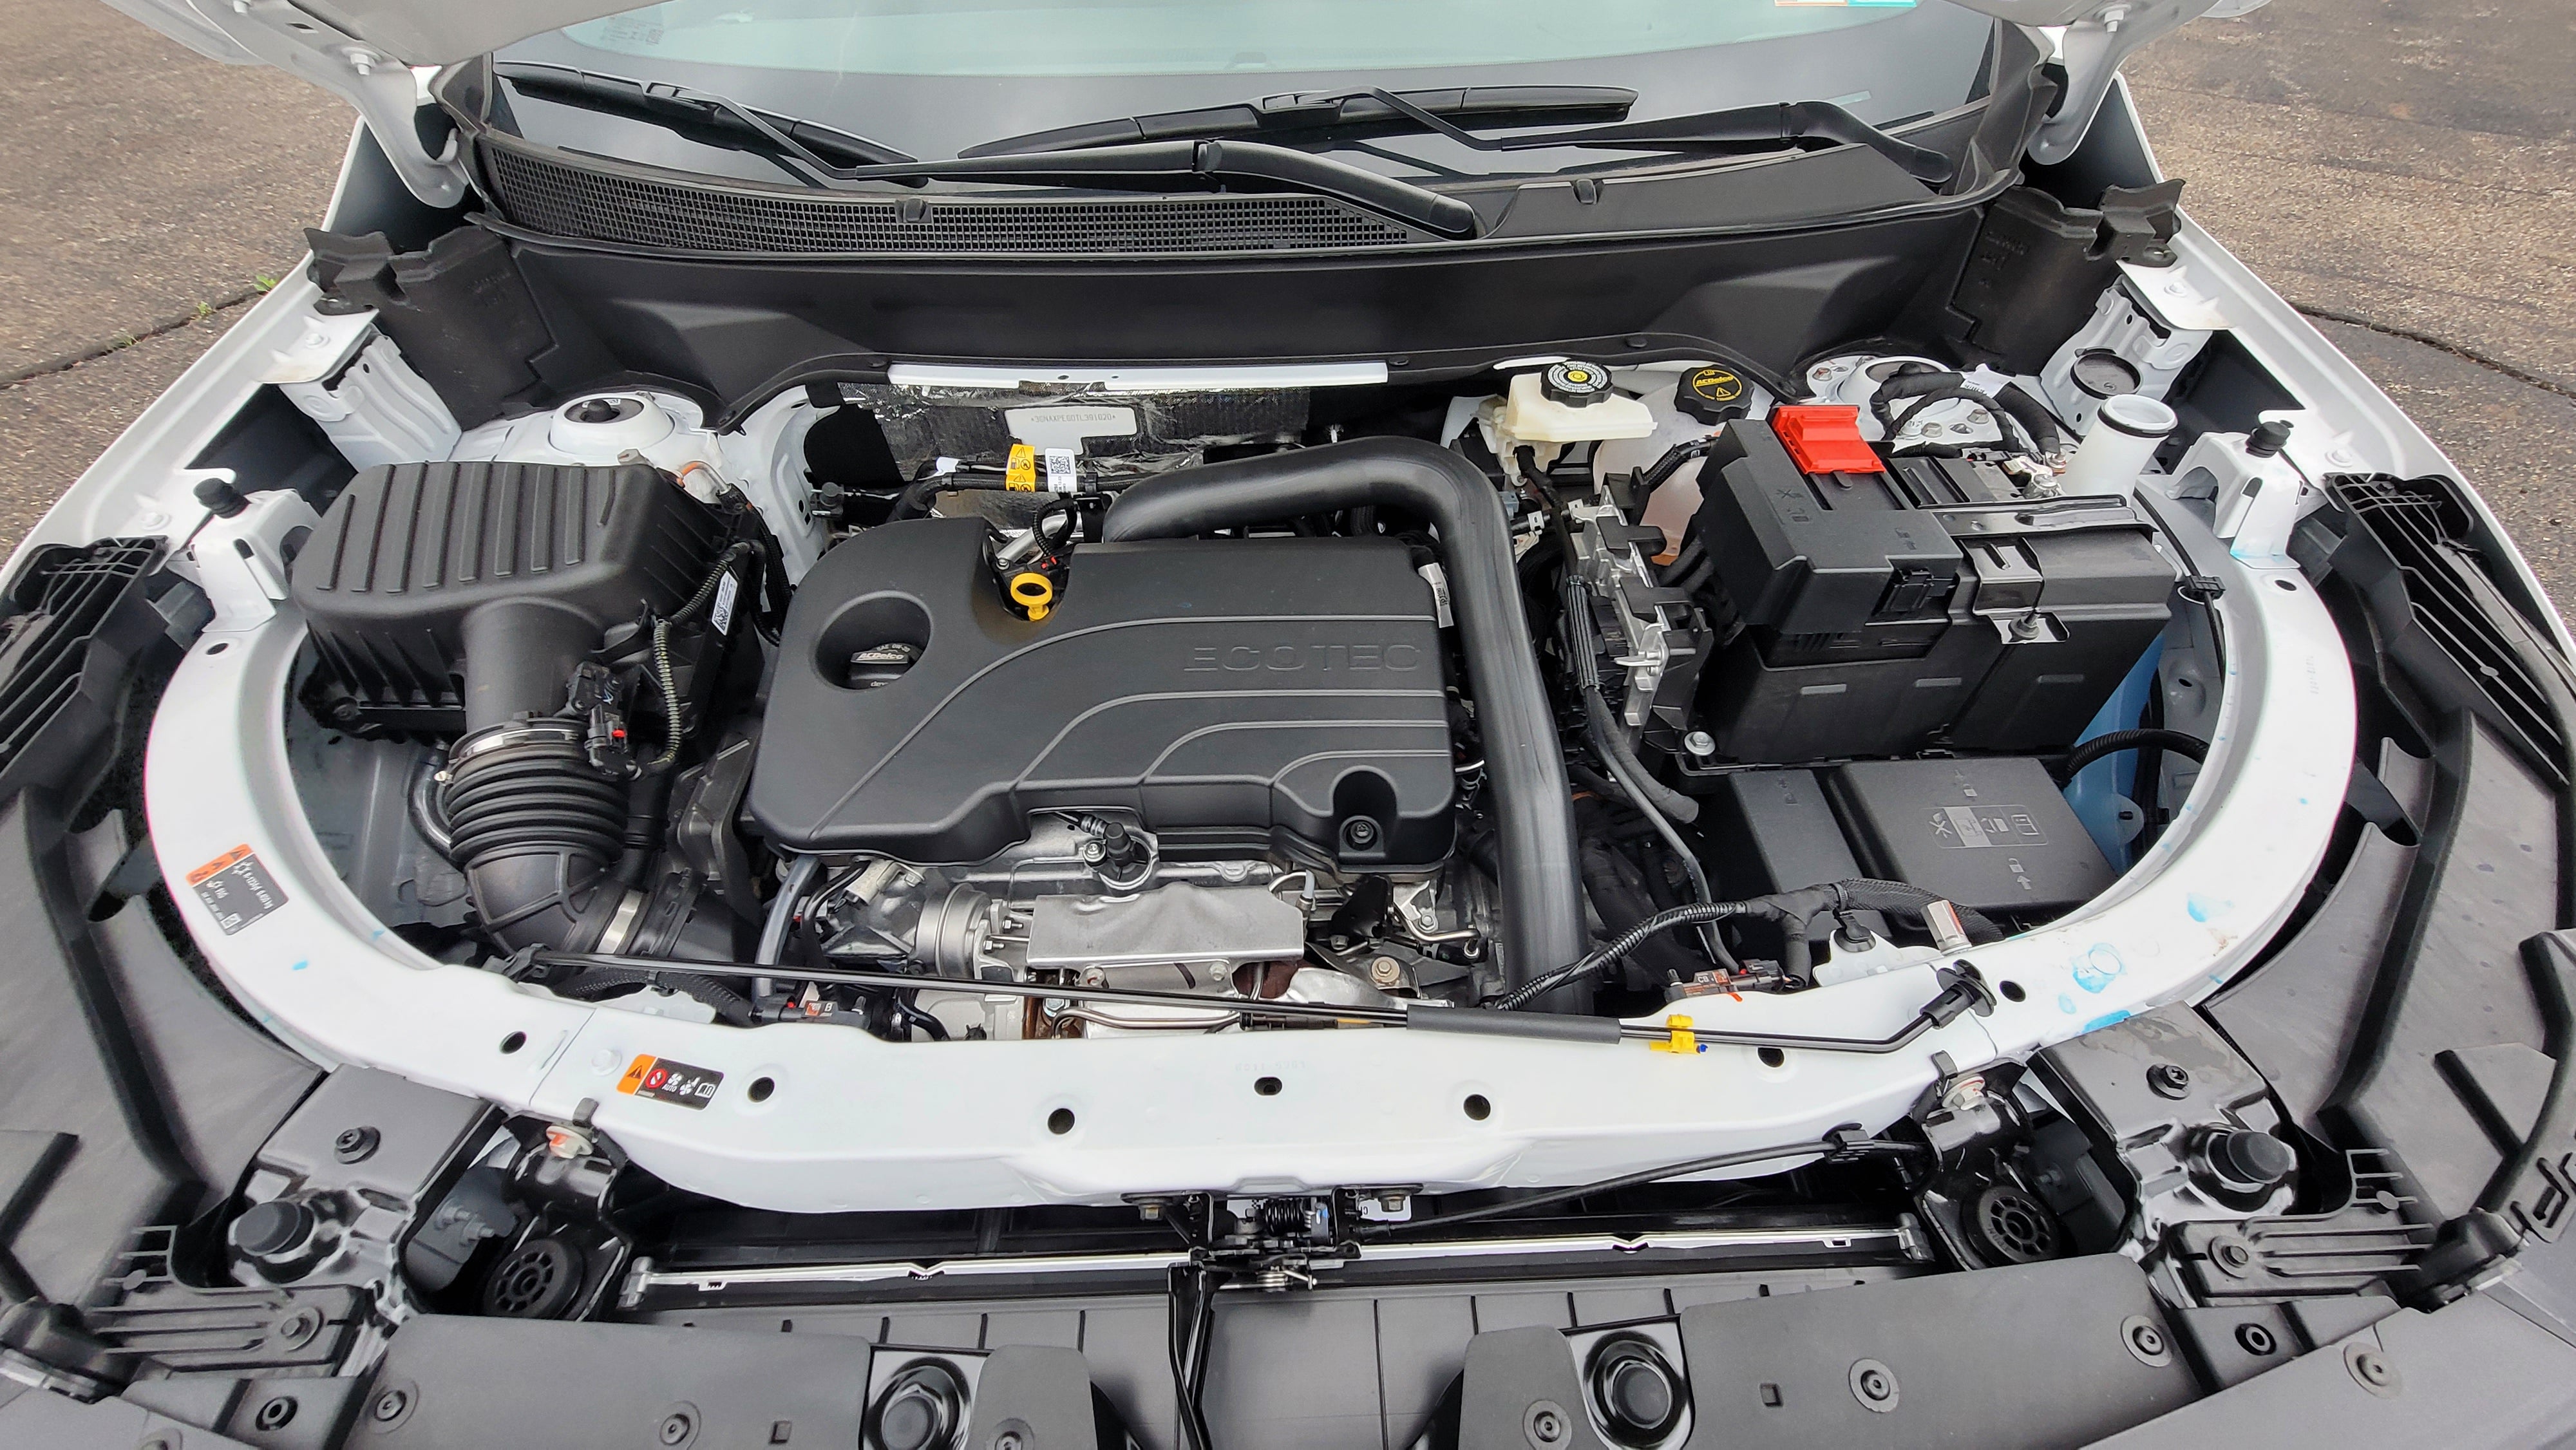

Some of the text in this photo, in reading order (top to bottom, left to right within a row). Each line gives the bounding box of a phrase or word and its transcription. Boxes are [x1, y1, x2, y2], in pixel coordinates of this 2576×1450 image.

[1695, 376, 1734, 386] ACDelco
[856, 652, 904, 661] ACDelco
[1183, 645, 1421, 672] ECOTEC
[661, 1083, 677, 1093] AUTO
